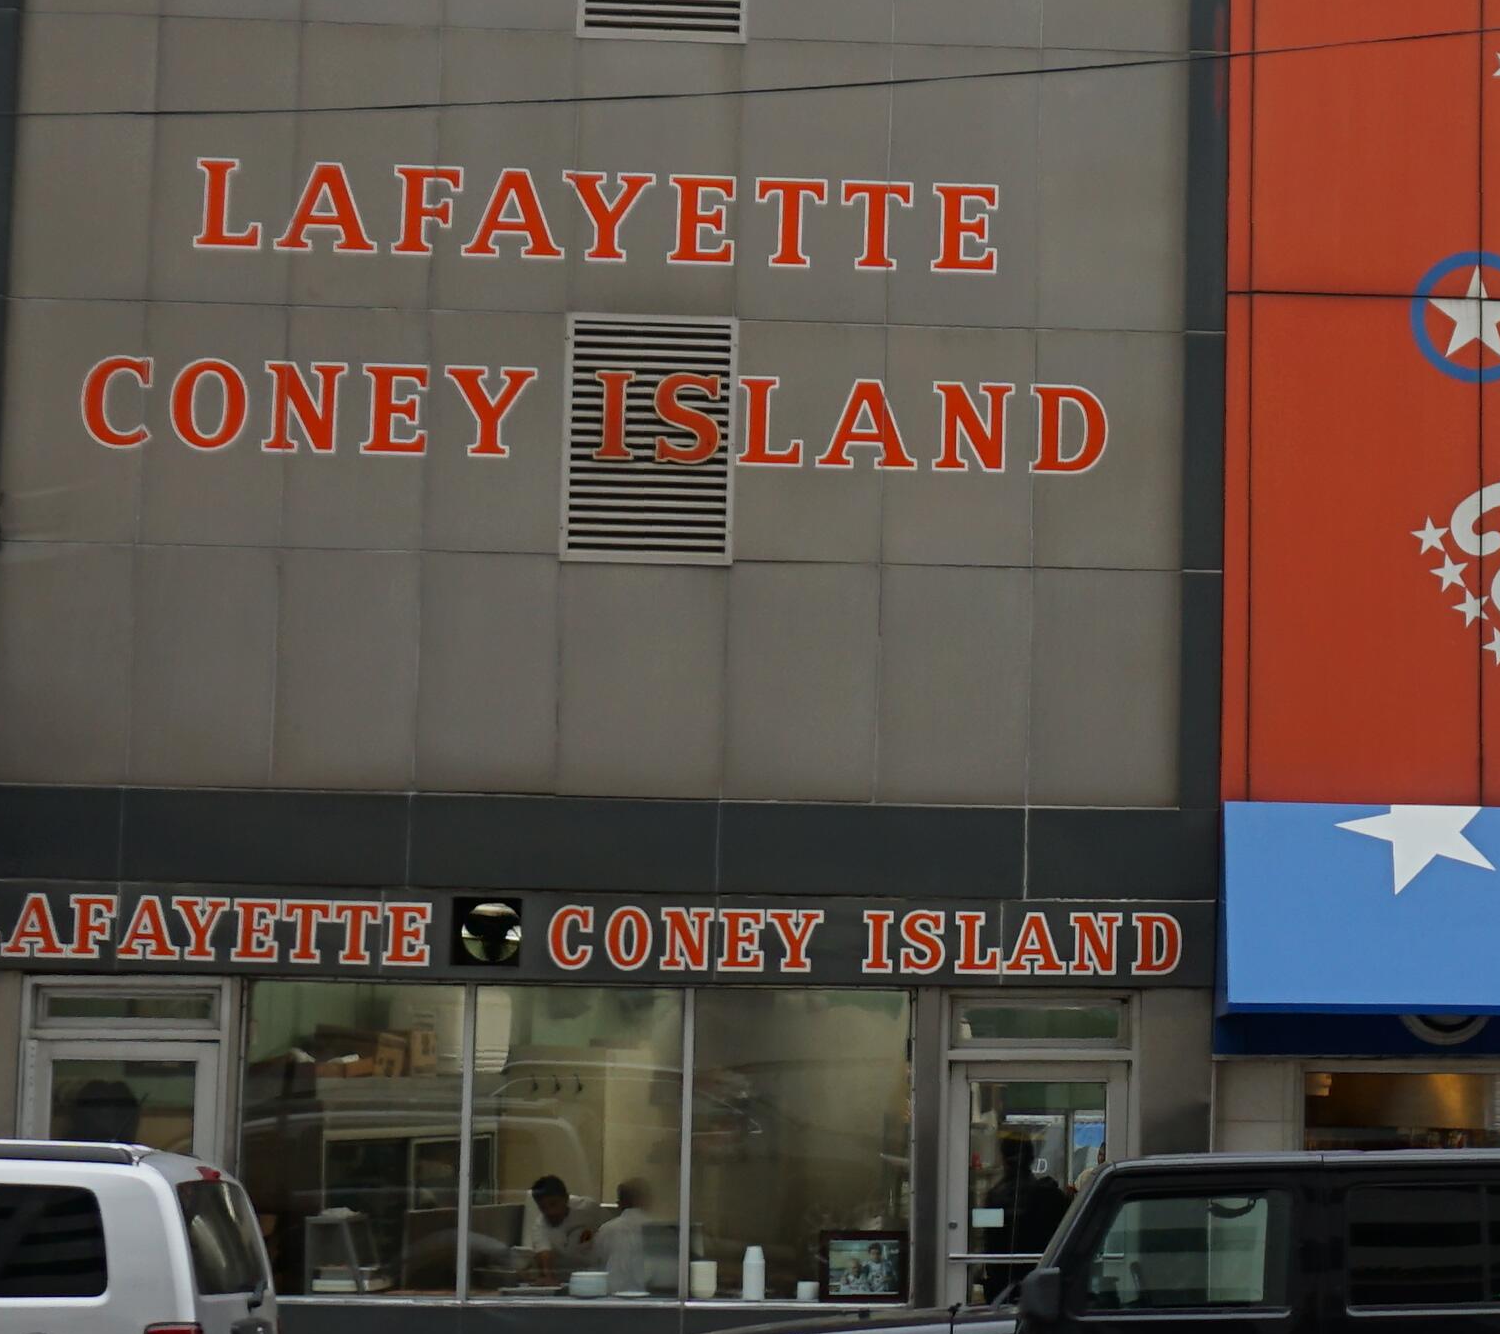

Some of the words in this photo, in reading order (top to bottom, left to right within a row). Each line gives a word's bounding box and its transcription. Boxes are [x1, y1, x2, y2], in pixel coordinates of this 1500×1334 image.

[192, 156, 1000, 275] LAFAYETTE
[80, 354, 538, 459] CONEY
[592, 368, 1111, 477] ISLAND
[547, 904, 825, 973] CONEY
[862, 909, 1183, 977] ISLAND
